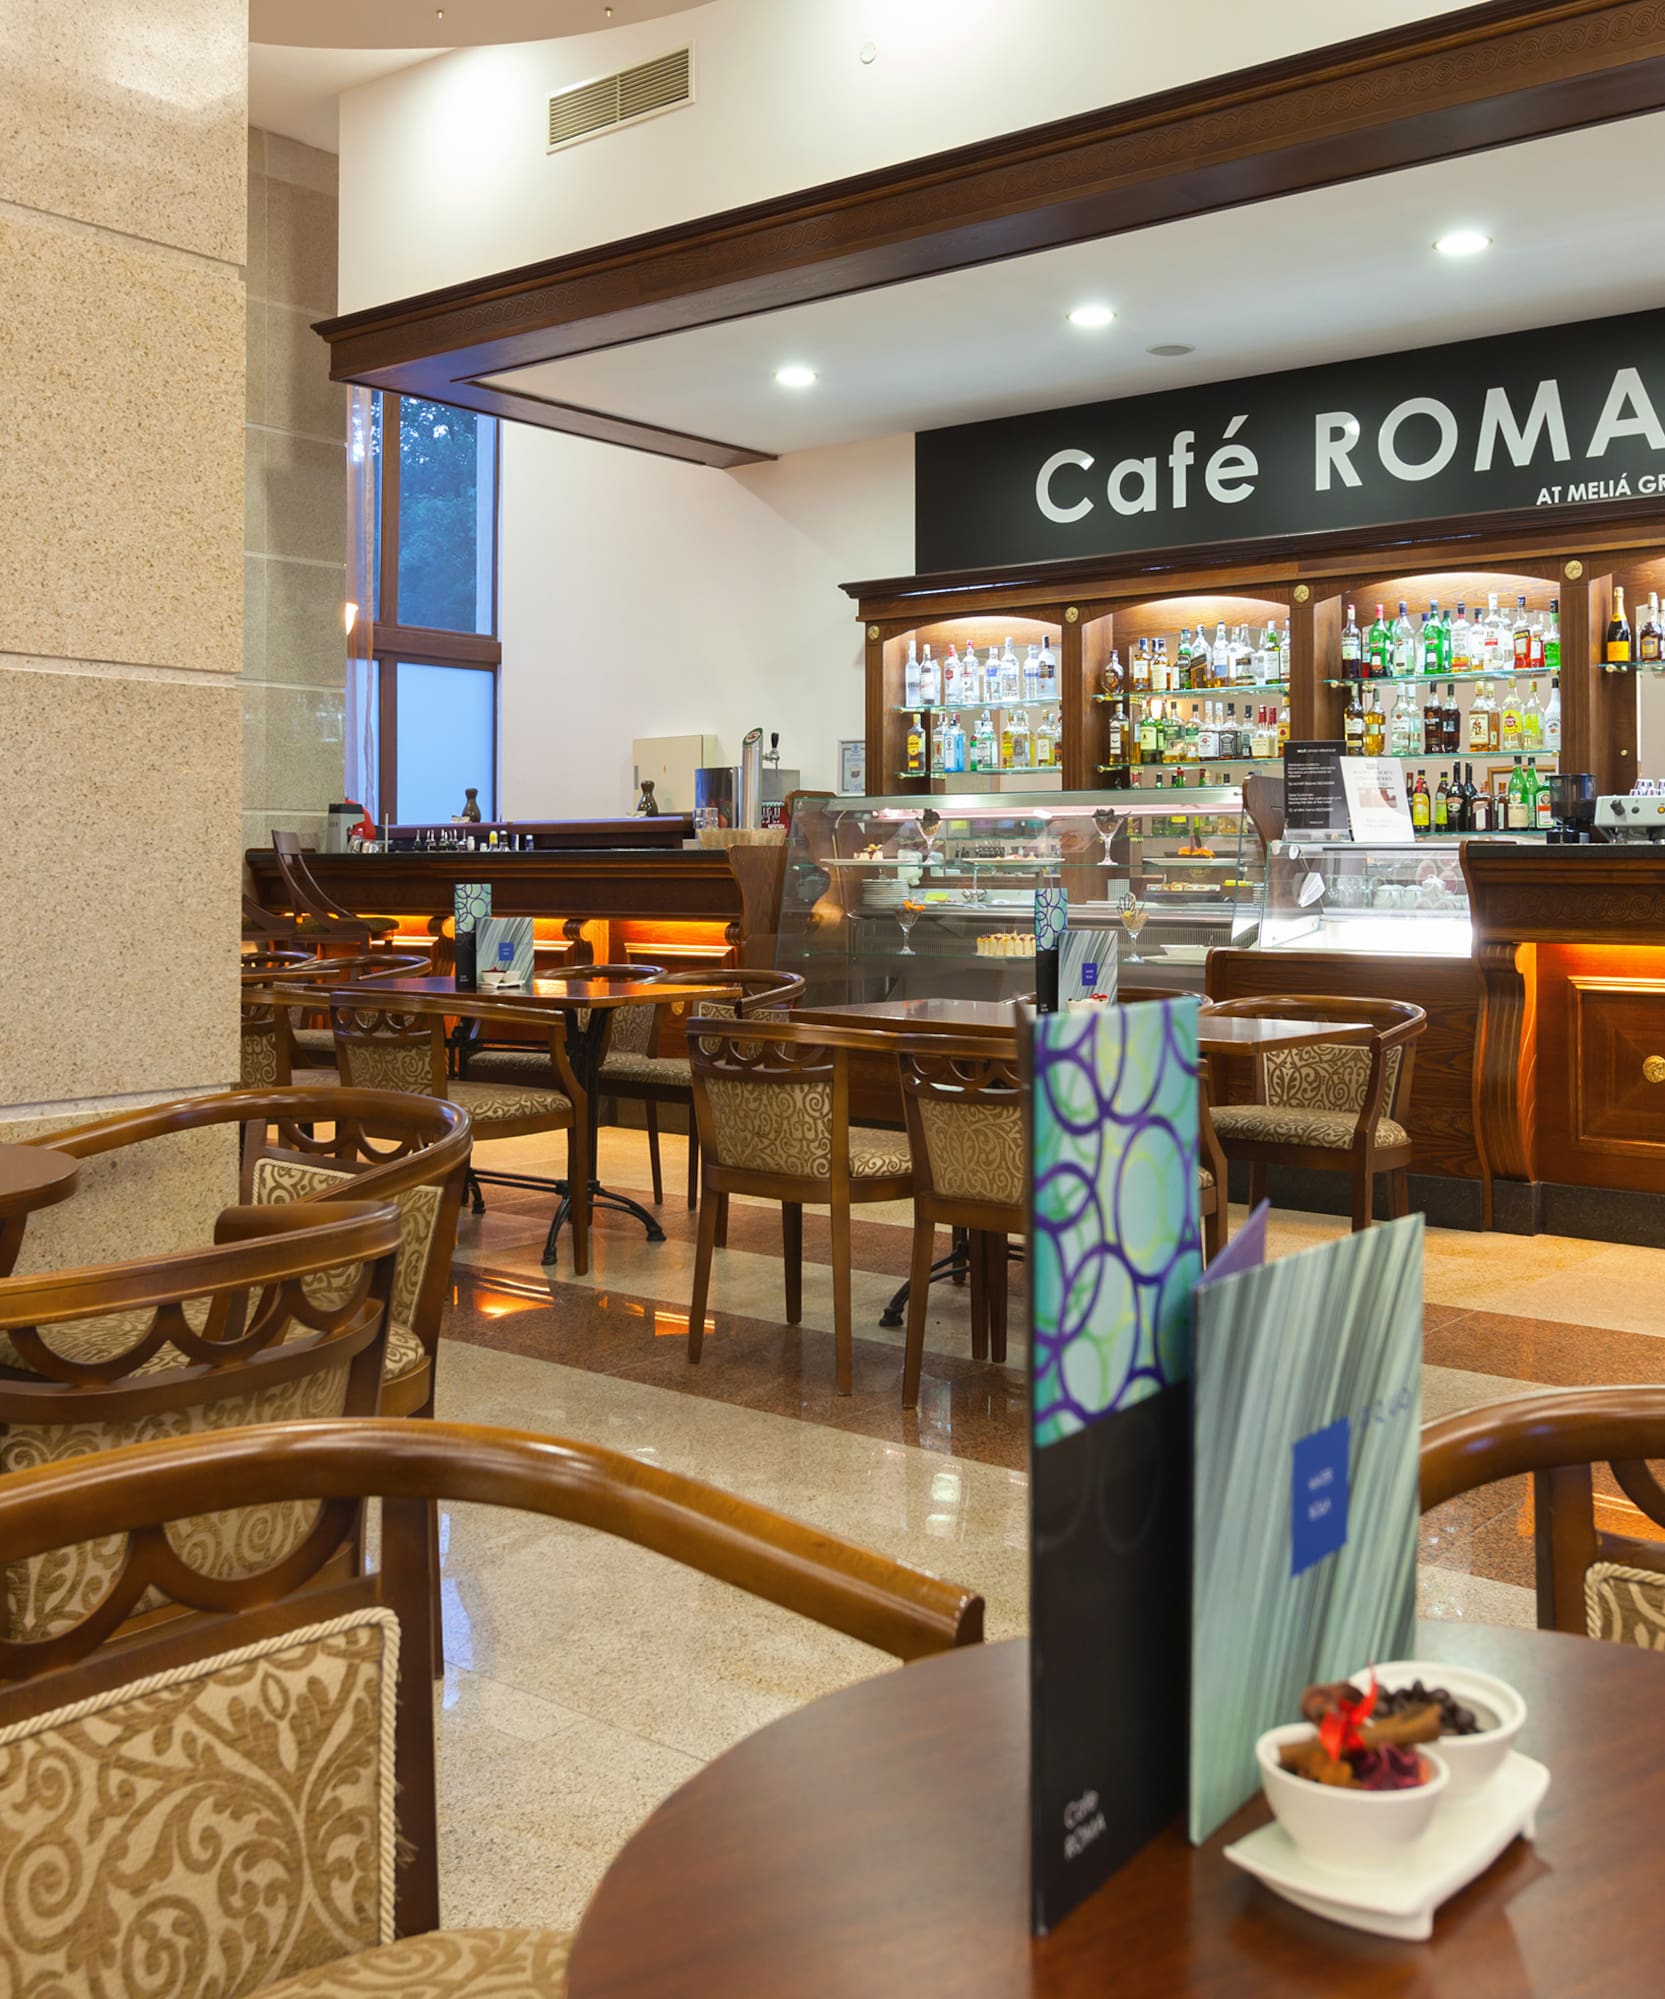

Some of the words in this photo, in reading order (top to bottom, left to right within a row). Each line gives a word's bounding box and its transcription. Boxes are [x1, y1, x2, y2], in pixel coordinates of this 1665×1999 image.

[1035, 415, 1259, 524] Café
[1315, 367, 1665, 492] ROMA
[1536, 486, 1562, 506] AT
[1567, 473, 1632, 502] MELIÁ
